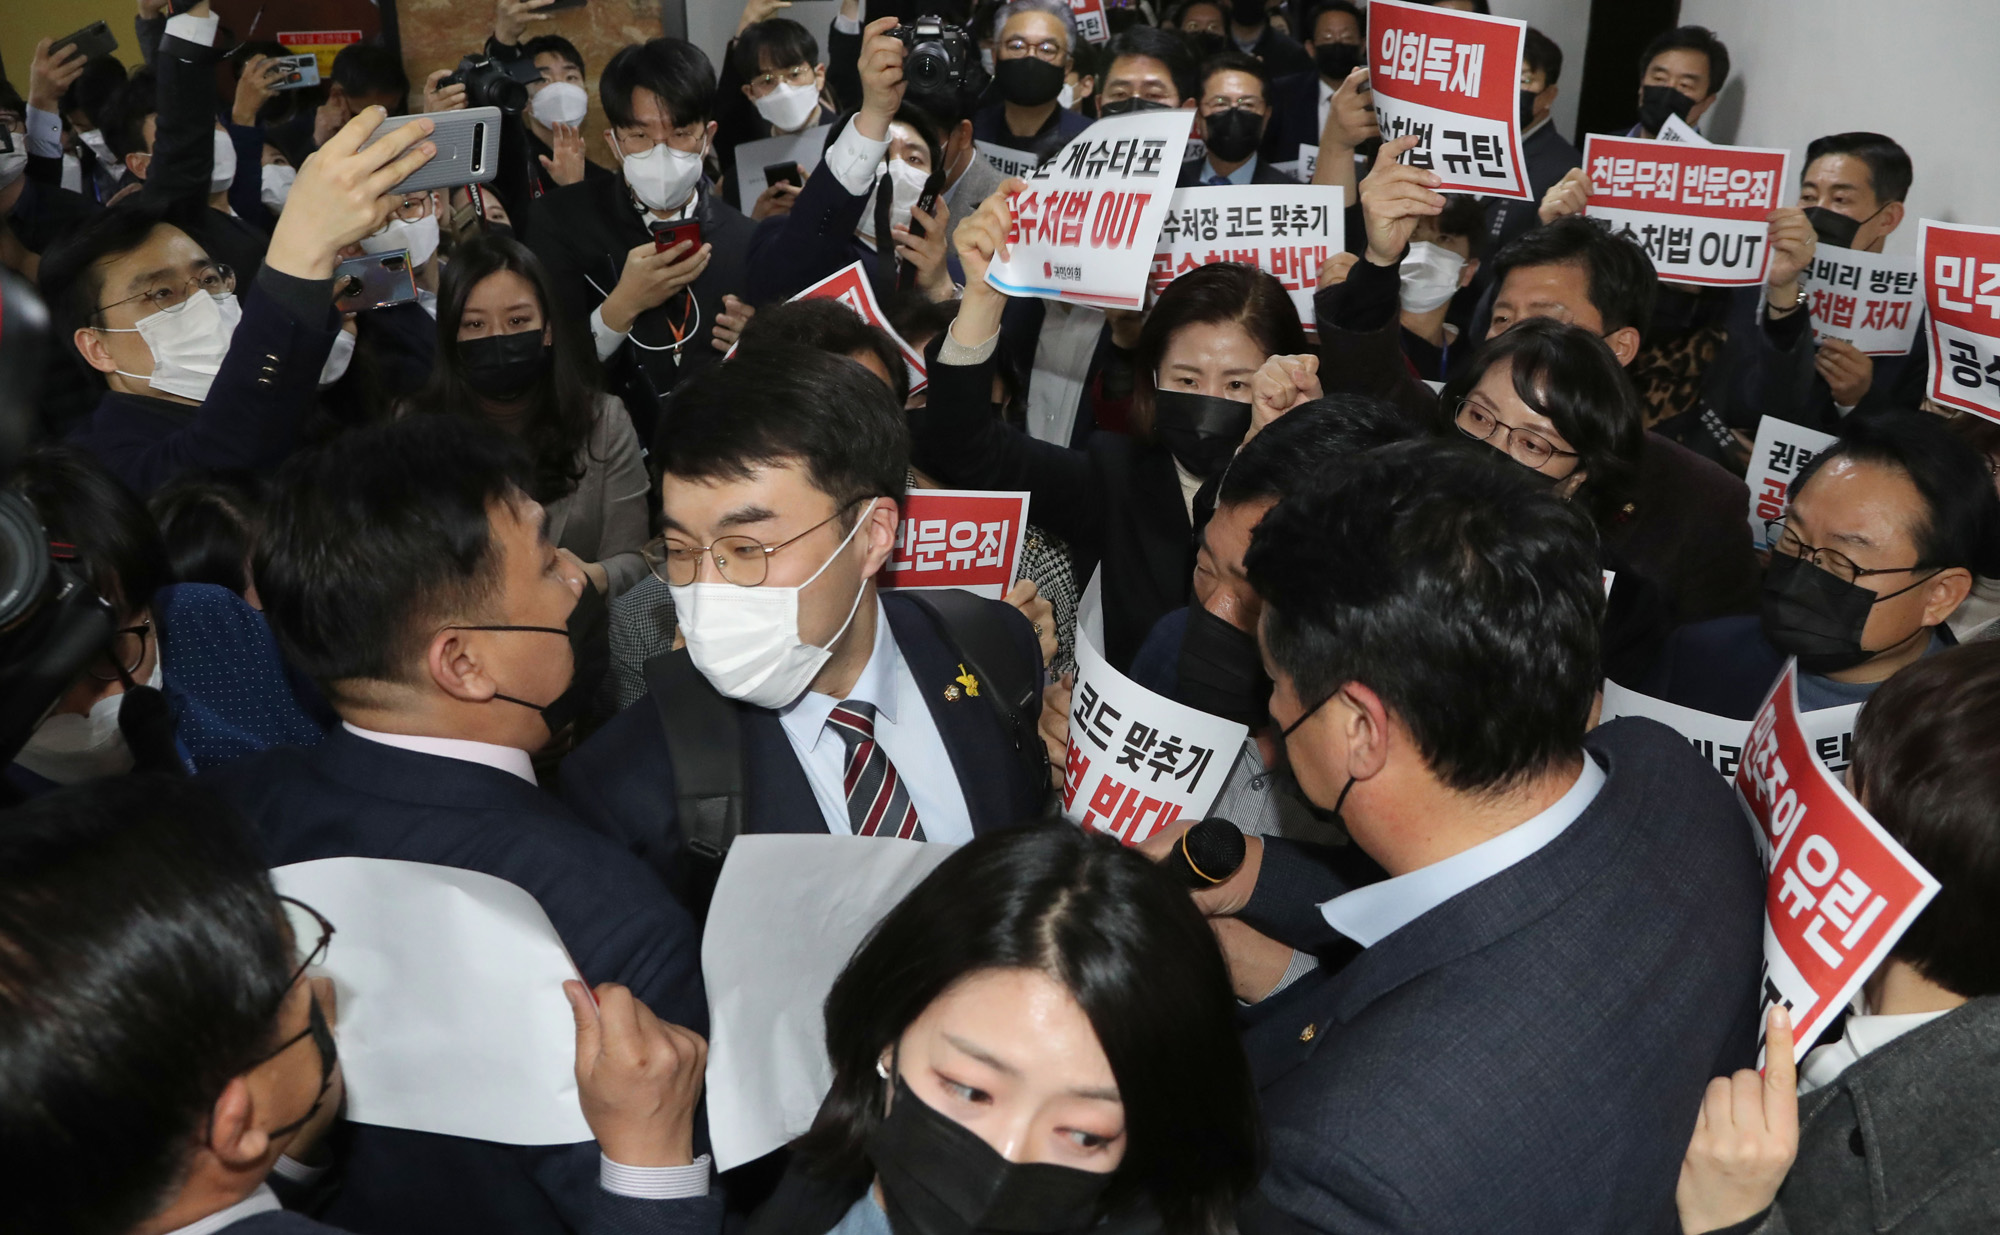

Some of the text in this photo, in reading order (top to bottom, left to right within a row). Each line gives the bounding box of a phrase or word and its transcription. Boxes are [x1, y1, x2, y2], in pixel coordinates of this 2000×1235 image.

[1379, 28, 1486, 98] 의회독재
[1442, 130, 1507, 178] 규탄
[469, 183, 482, 216] Cano
[1591, 156, 1776, 209] 친문무죄 반문유죄
[1090, 190, 1152, 250] OUT
[1156, 204, 1328, 244] 수처장 코드 맞추기
[1053, 265, 1082, 281] 국민의힘
[1270, 245, 1329, 292] 반대
[1698, 231, 1762, 269] OUT
[1869, 269, 1918, 295] 방탄
[1860, 300, 1912, 330] 저지
[885, 518, 1010, 572] 반문유죄
[1073, 681, 1122, 752] 코드
[1115, 720, 1215, 794] 맞추기
[1080, 773, 1184, 850] 반대
[1777, 834, 1888, 970] 유린
